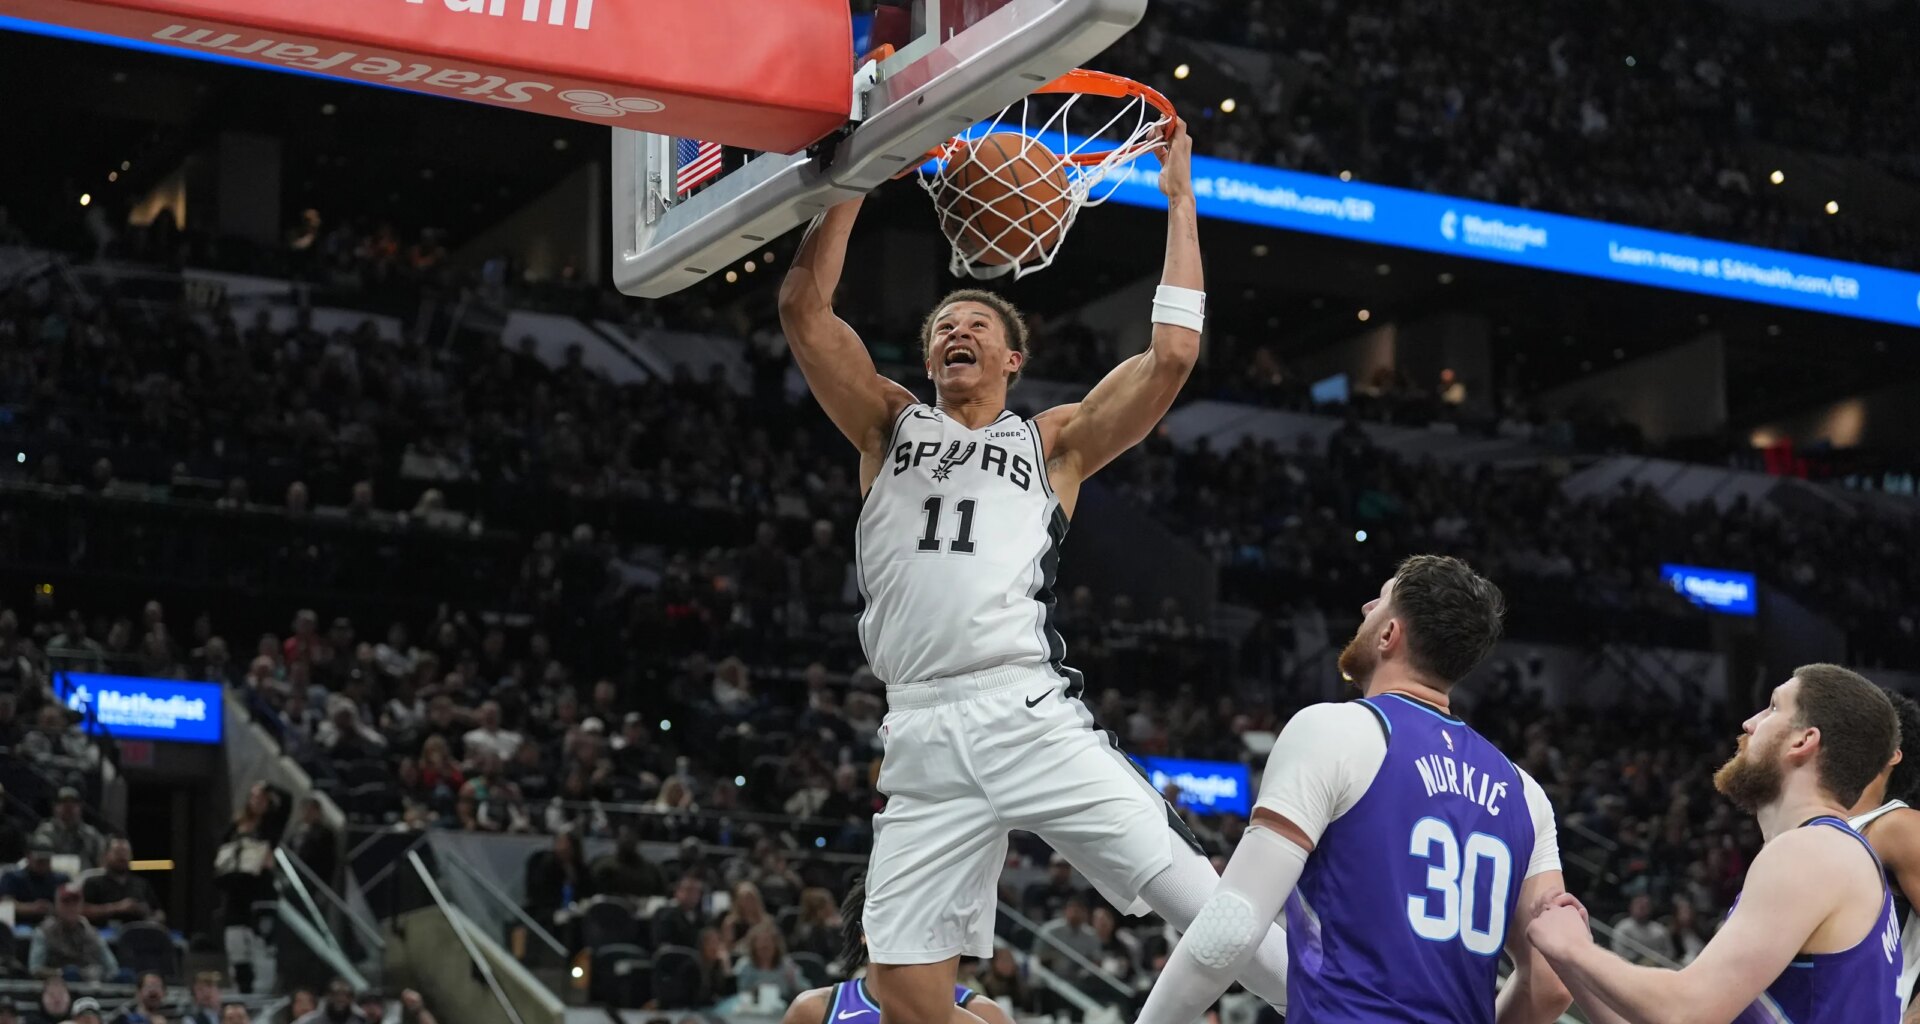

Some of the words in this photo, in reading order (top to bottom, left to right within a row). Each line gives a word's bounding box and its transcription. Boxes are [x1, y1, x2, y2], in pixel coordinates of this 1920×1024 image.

[1608, 240, 1656, 267] Learn
[1657, 252, 1700, 276] more
[1700, 258, 1719, 278] at
[990, 431, 1021, 439] LEDGER
[915, 494, 978, 556] 11
[97, 690, 207, 721] Methodist
[1415, 754, 1508, 816] NURKIĆ
[1407, 816, 1512, 956] 30
